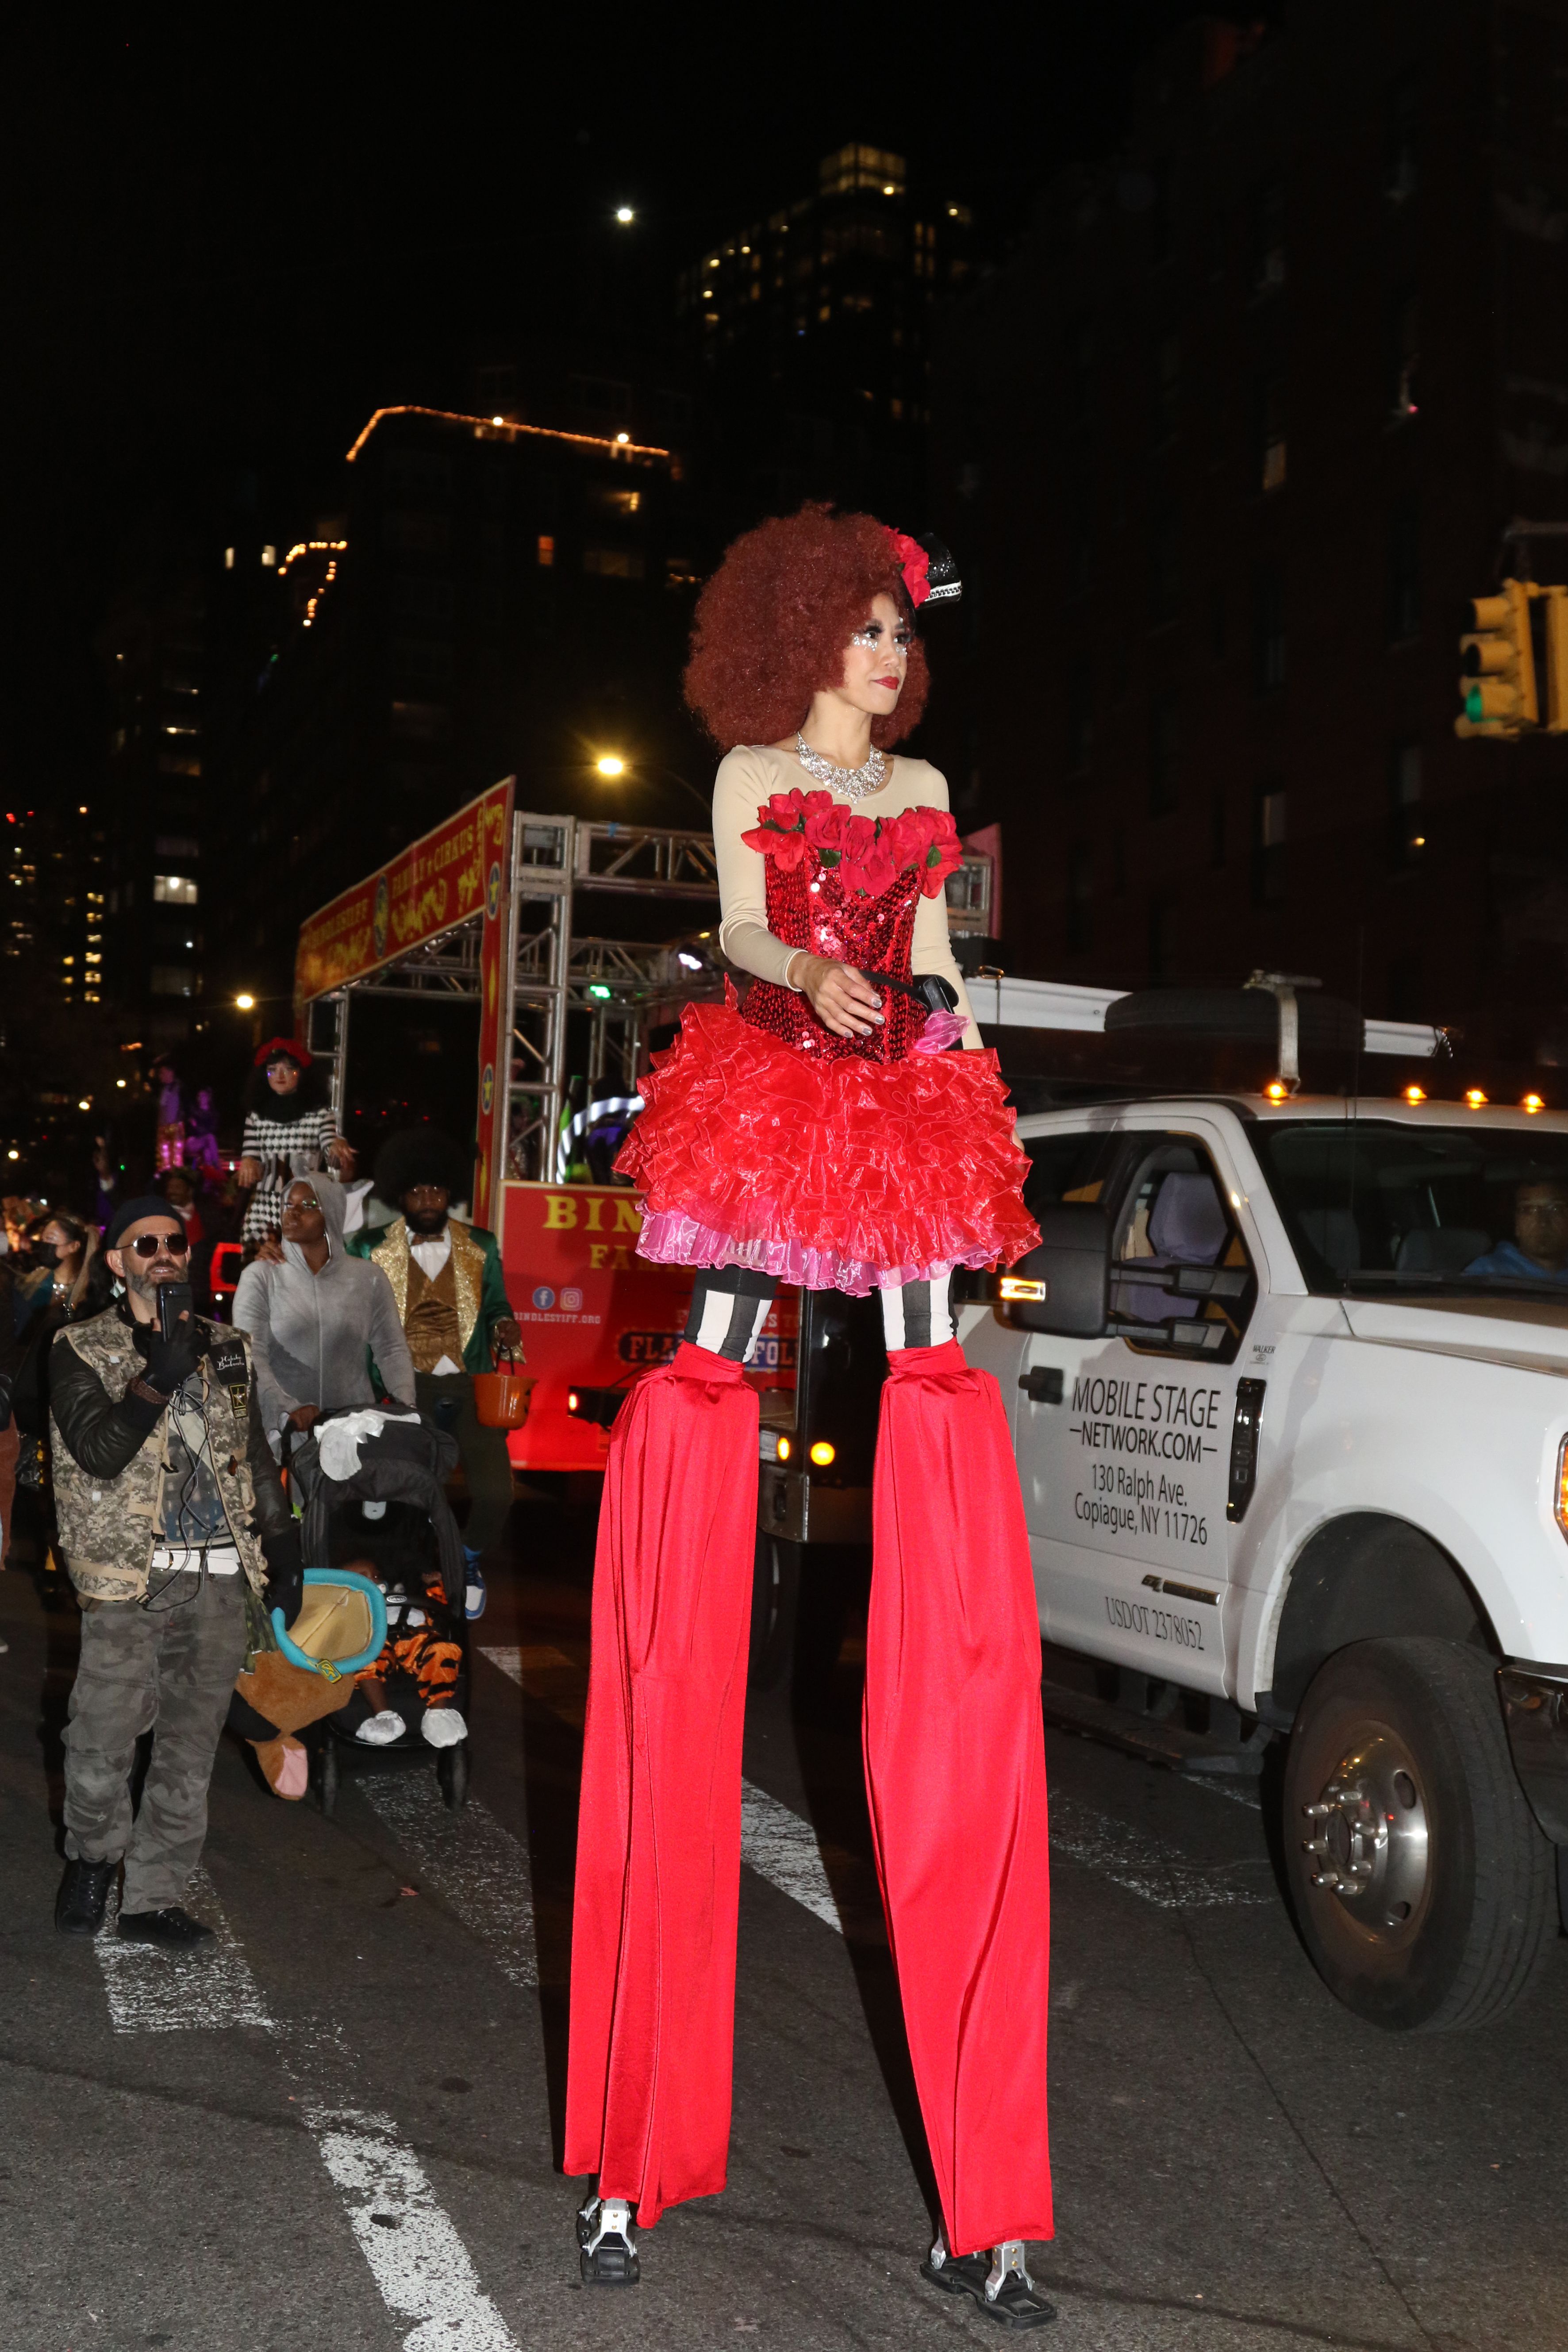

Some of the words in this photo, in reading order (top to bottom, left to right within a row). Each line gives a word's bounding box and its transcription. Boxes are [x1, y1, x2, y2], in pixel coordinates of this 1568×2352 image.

[1253, 1345, 1276, 1354] WALKER
[1072, 1376, 1148, 1420] MOBILE
[1151, 1384, 1221, 1429] STAGE
[1092, 1464, 1114, 1493] 130
[1118, 1467, 1154, 1506] Ralph
[1158, 1474, 1188, 1507] Ave.
[1075, 1492, 1138, 1535] Copiague,
[1141, 1505, 1160, 1535] NY
[1165, 1510, 1208, 1545] 11726
[1105, 1596, 1149, 1635] USDOT
[1152, 1609, 1204, 1651] 2378052
